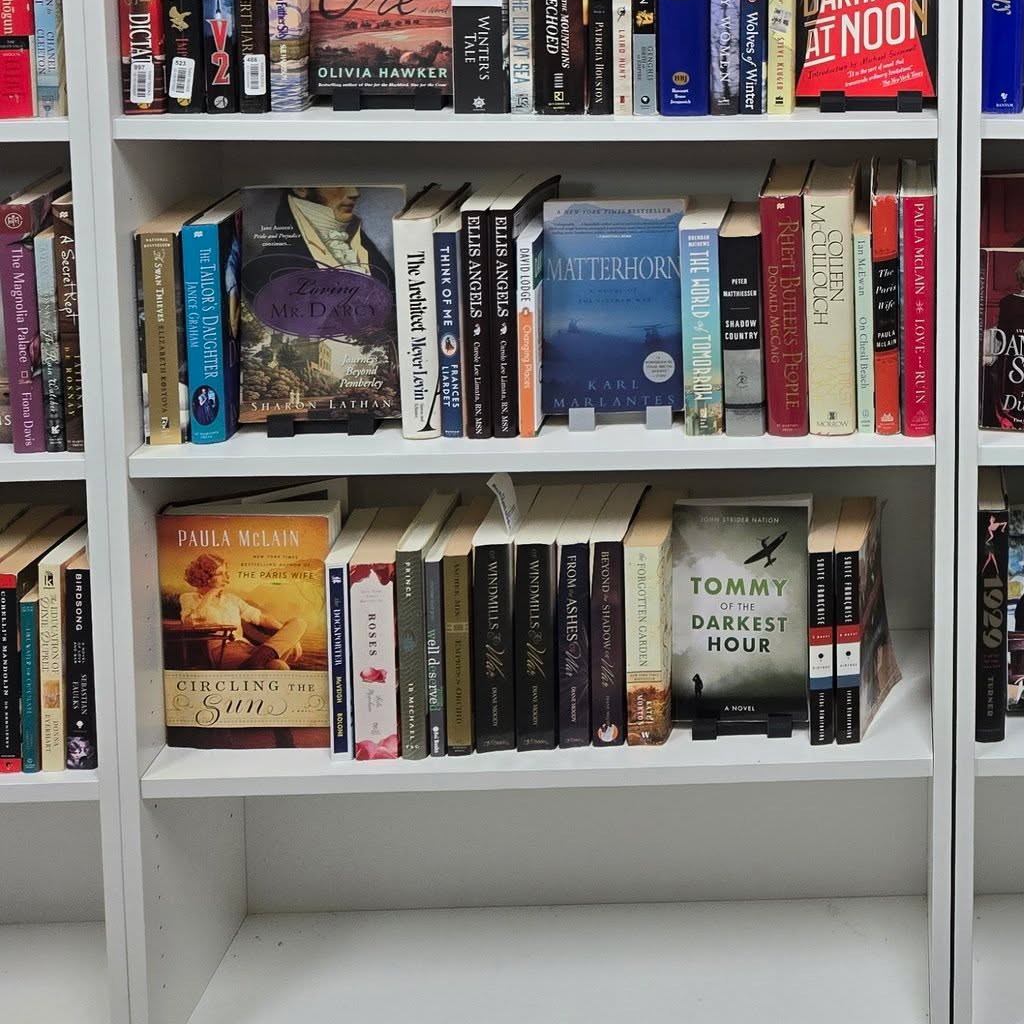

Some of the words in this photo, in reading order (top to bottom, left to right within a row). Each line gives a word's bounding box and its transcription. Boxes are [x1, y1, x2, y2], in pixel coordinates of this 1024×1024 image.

[804, 24, 835, 59] AT
[318, 68, 370, 78] OLIVIA
[379, 68, 447, 78] HAWKER
[547, 257, 681, 281] MATTERHORN
[879, 269, 894, 277] The
[876, 285, 896, 295] Paris
[878, 300, 895, 311] Wife
[726, 320, 757, 328] SHADOW
[725, 332, 758, 340] COUNTRY
[877, 330, 895, 338] PAULA
[877, 339, 897, 347] McLAIN
[588, 380, 639, 391] KARL
[251, 400, 317, 411] SHARON
[329, 399, 393, 408] LATHAN
[553, 395, 675, 408] MARLANTES
[178, 529, 230, 548] PAULA
[239, 529, 300, 548] McLAIN
[237, 571, 256, 579] THE
[259, 571, 288, 580] PARIS
[291, 572, 315, 580] WIFE
[690, 577, 789, 597] TOMMY
[75, 573, 83, 632] BIRDSONG
[720, 602, 735, 611] OF
[737, 602, 755, 611] THE
[691, 615, 787, 633] DARKEST
[367, 613, 377, 657] ROSES
[707, 637, 771, 654] HOUR
[176, 681, 280, 692] CIRCLING
[288, 684, 316, 692] THE
